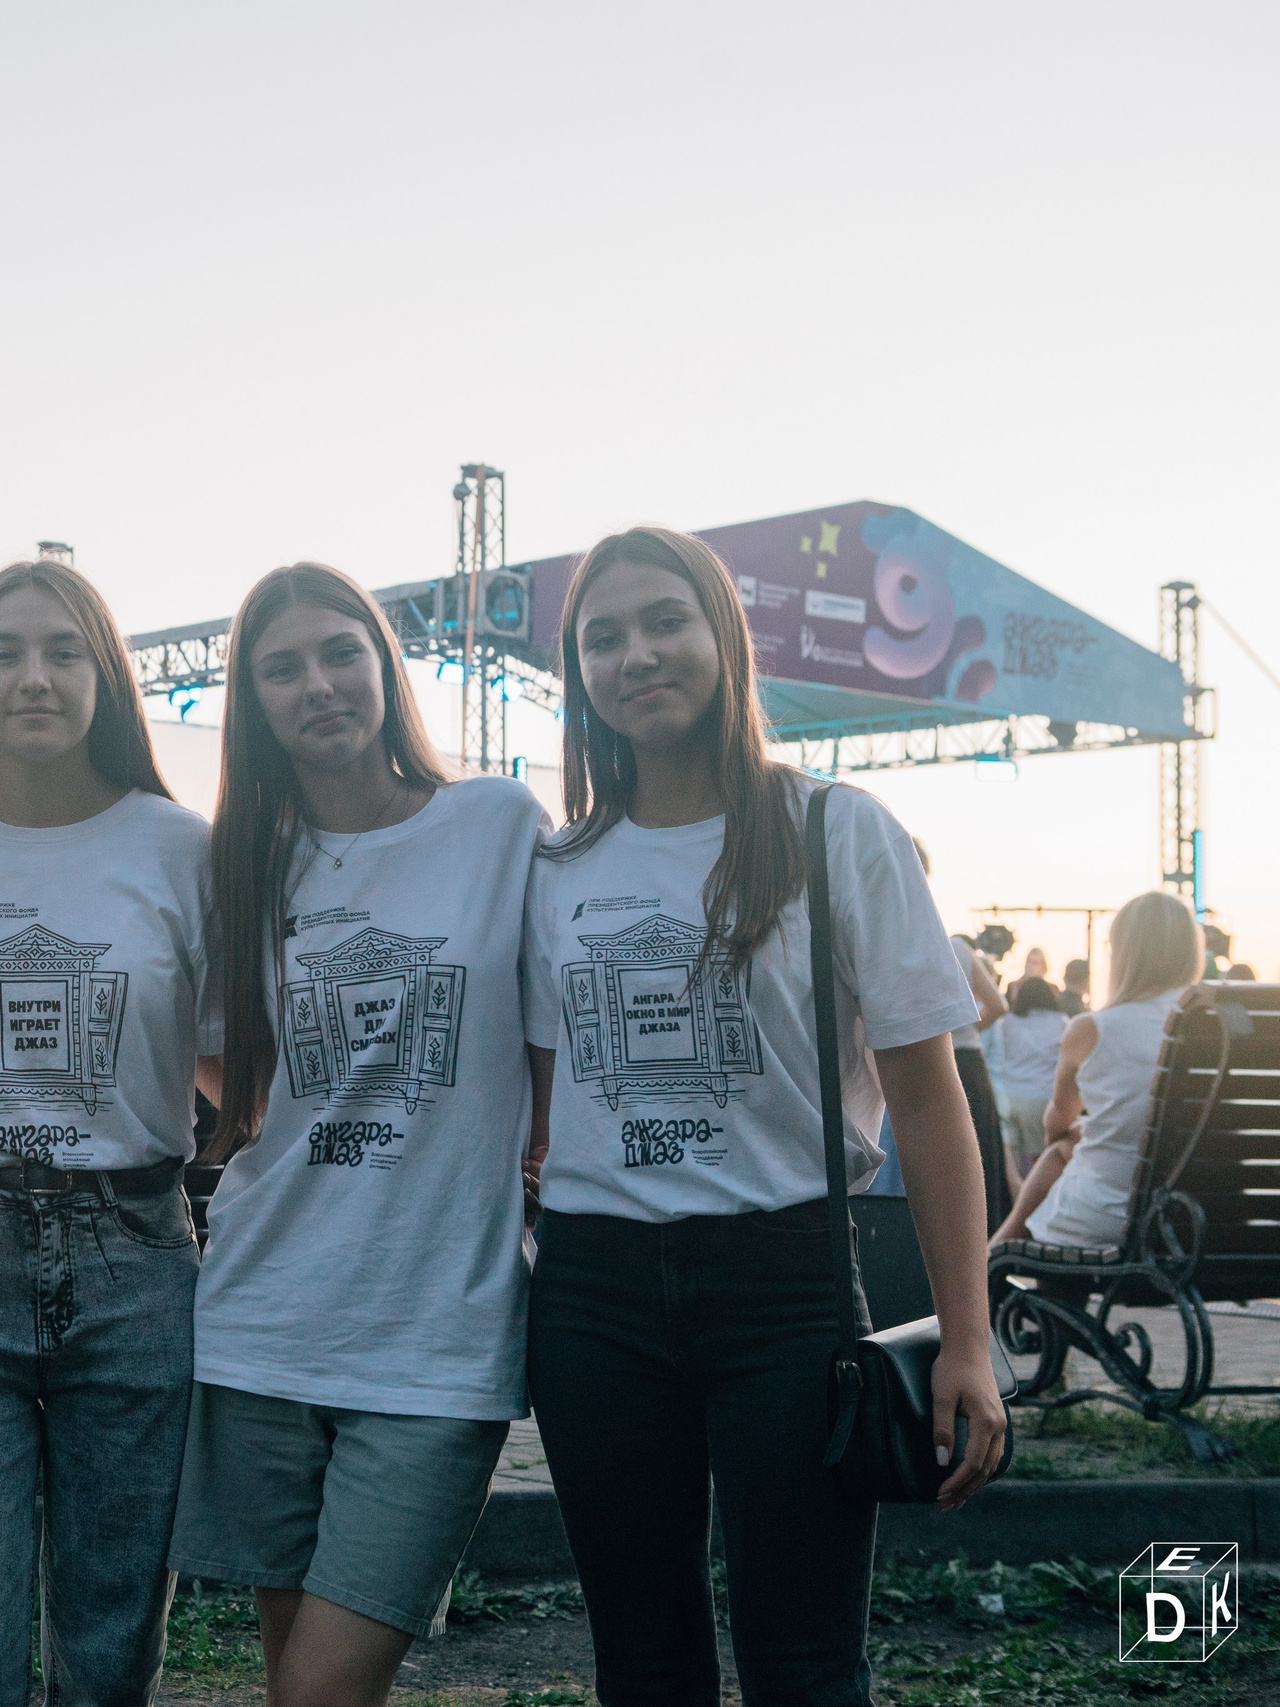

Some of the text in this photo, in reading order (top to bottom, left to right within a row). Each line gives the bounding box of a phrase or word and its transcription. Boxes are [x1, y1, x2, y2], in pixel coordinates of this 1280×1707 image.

[633, 993, 675, 1005] АНГАРА
[8, 1000, 61, 1012] ВНУТРИ
[354, 998, 396, 1017] ДЖАЗ
[626, 1007, 690, 1020] ОКНО В МИР
[10, 1018, 61, 1031] ИГРАЕТ
[364, 1018, 387, 1034] ДЛ
[639, 1022, 681, 1035] ДЖАЗА
[14, 1036, 58, 1051] ДЖАЗ
